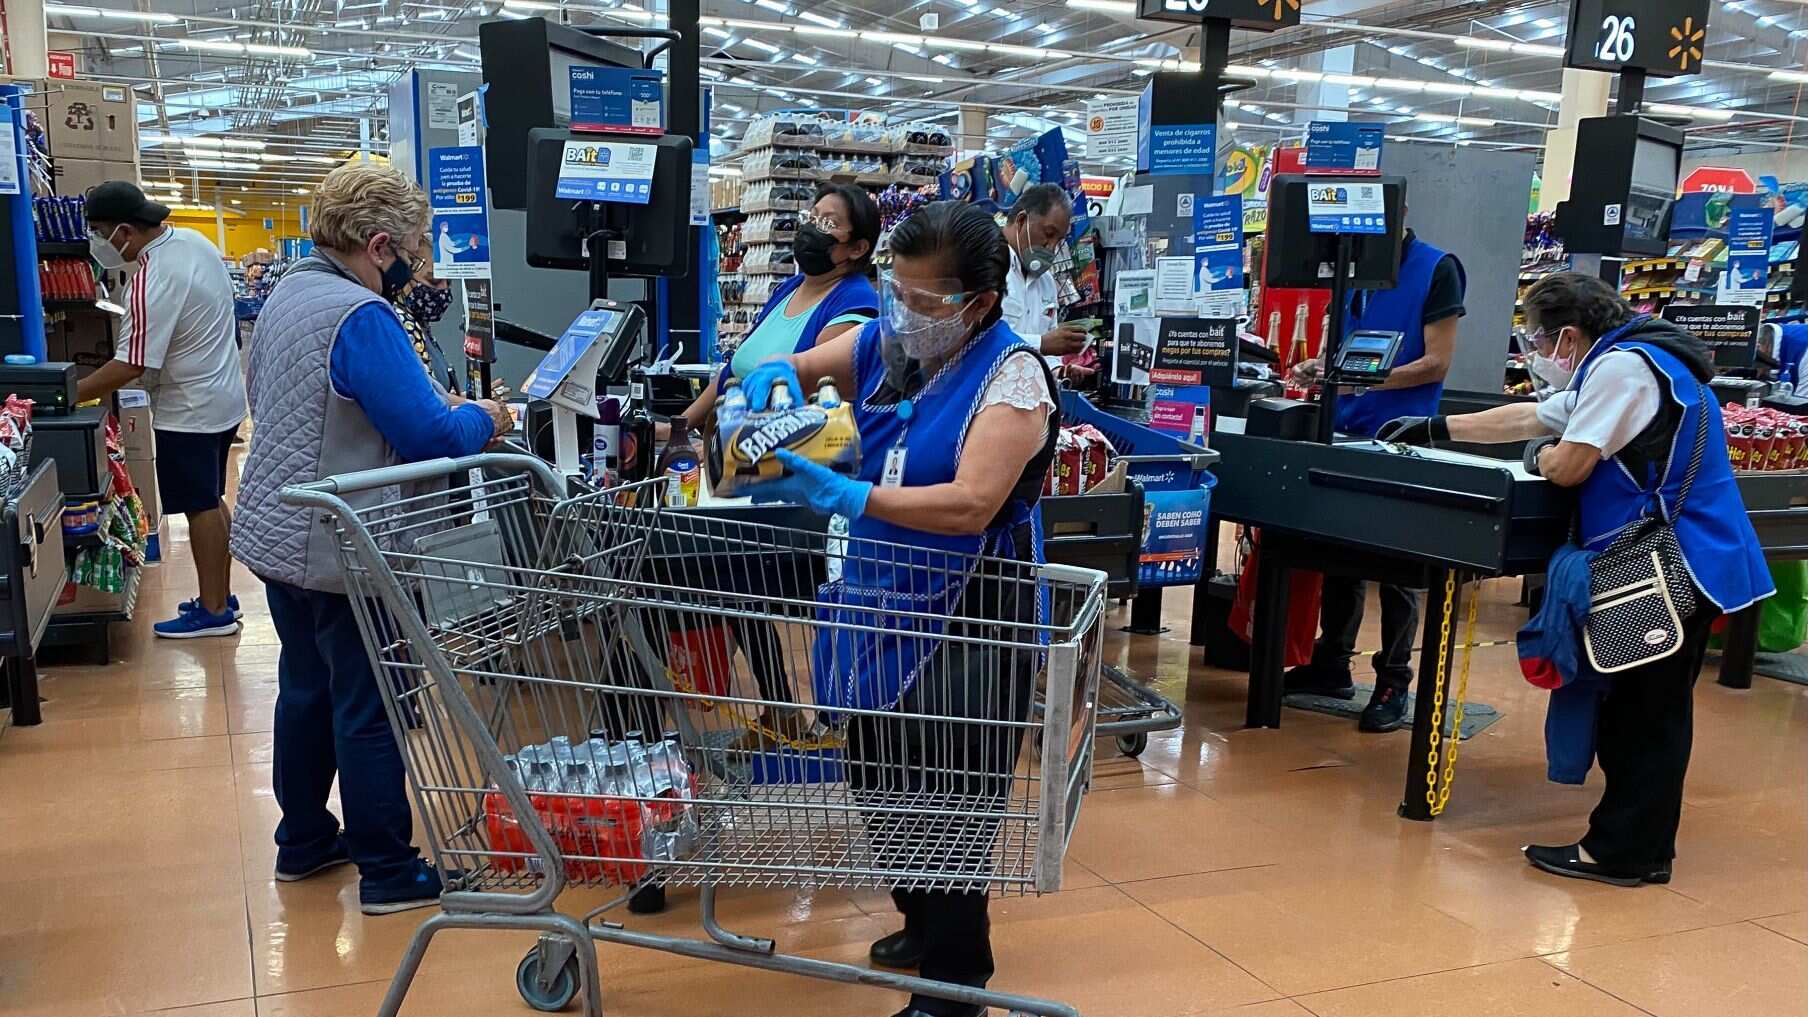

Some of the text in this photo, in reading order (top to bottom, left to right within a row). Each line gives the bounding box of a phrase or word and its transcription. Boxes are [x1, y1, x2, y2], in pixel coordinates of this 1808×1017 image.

[1600, 15, 1635, 62] 26
[572, 71, 594, 80] cashi
[1727, 311, 1746, 321] bait
[1209, 325, 1226, 337] bait
[1180, 348, 1192, 356] por
[1134, 473, 1165, 483] Walmart
[1157, 510, 1202, 521] SABEN COMO
[1155, 517, 1202, 528] DEBEN SABER
